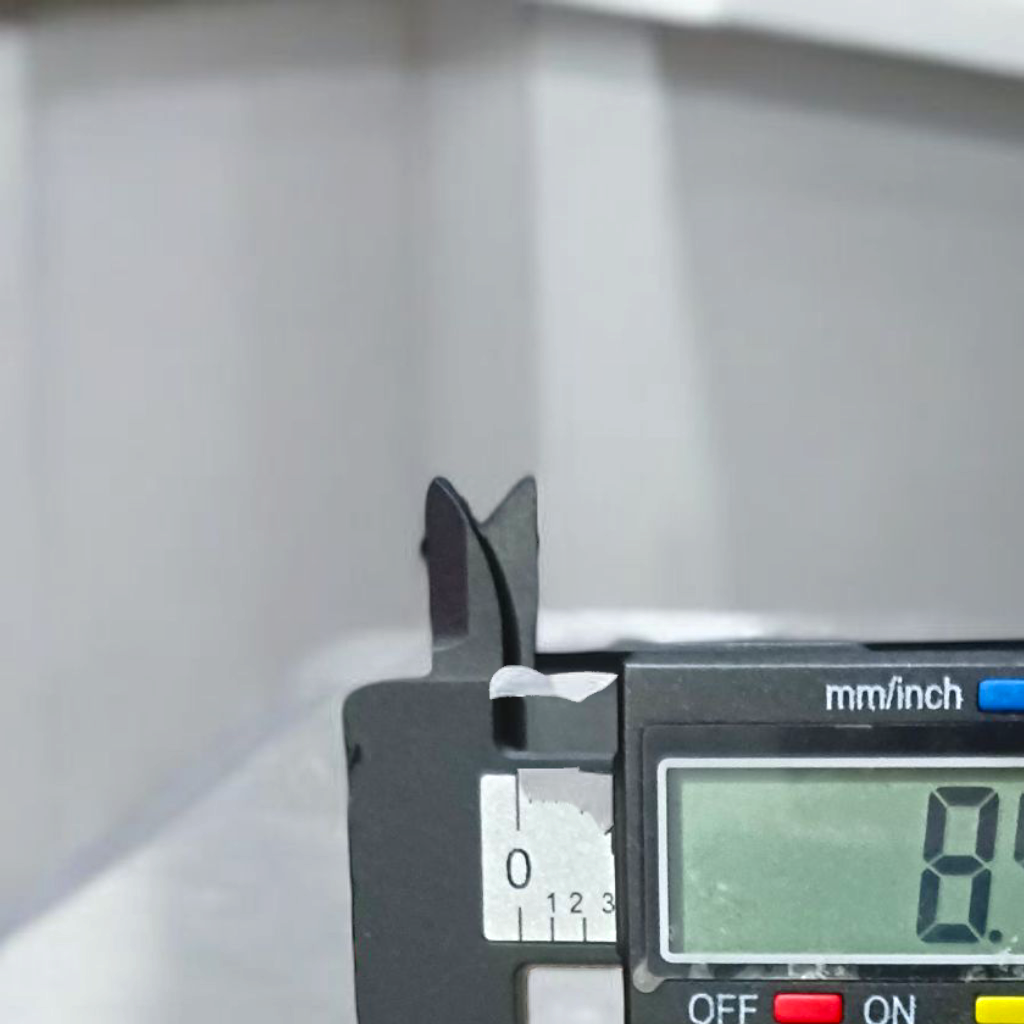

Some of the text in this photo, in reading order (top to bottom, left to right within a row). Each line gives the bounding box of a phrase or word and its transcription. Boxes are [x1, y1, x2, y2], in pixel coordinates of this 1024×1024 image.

[825, 677, 964, 711] mm/inch
[506, 848, 531, 889] 0
[547, 892, 615, 914] 1 2 3
